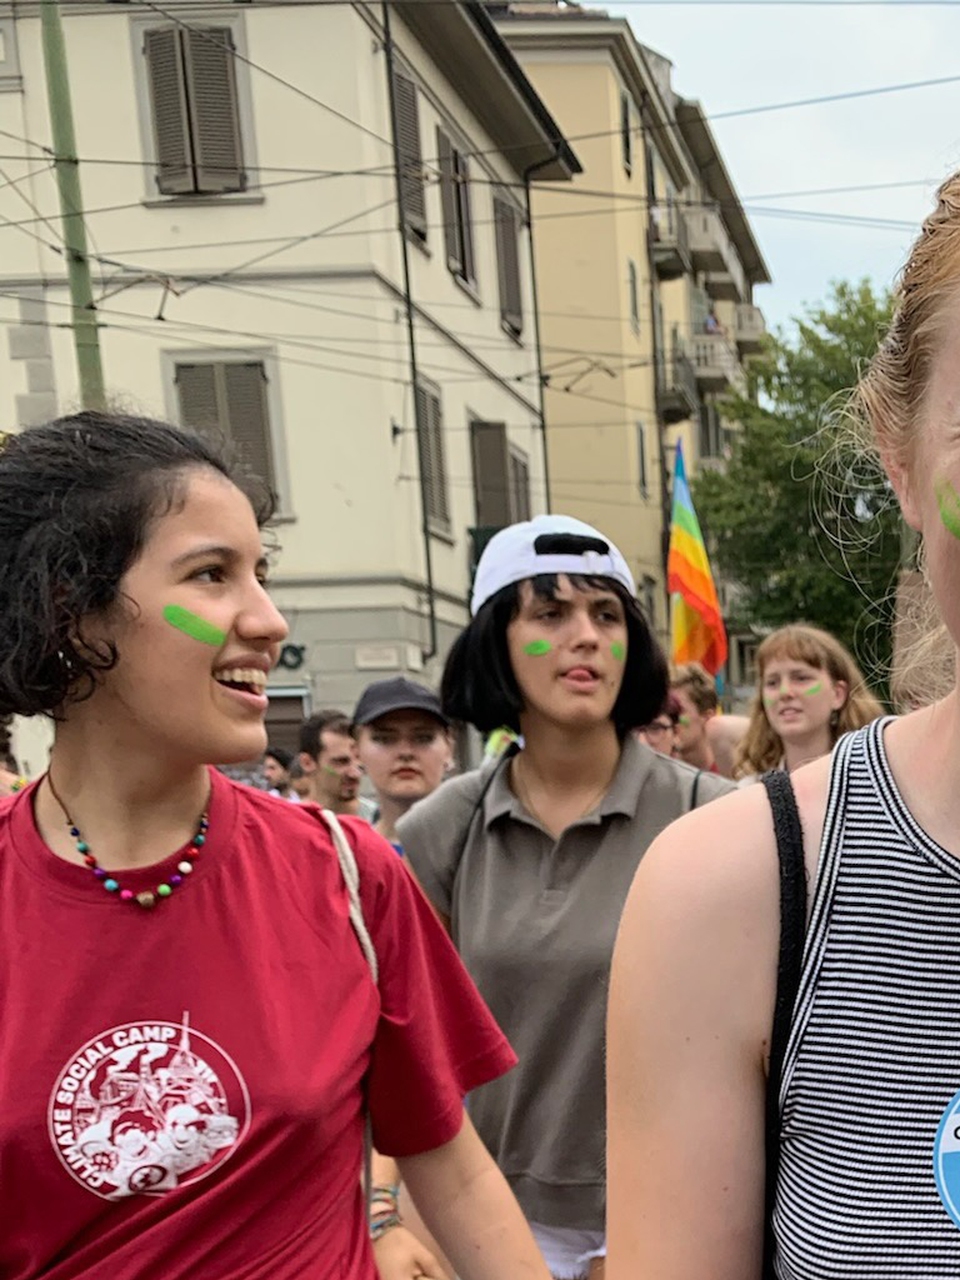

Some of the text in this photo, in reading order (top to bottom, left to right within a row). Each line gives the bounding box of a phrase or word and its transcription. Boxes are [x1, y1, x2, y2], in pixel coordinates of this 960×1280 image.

[54, 1025, 177, 1187] CLIMATE SOCIAL CAMP
